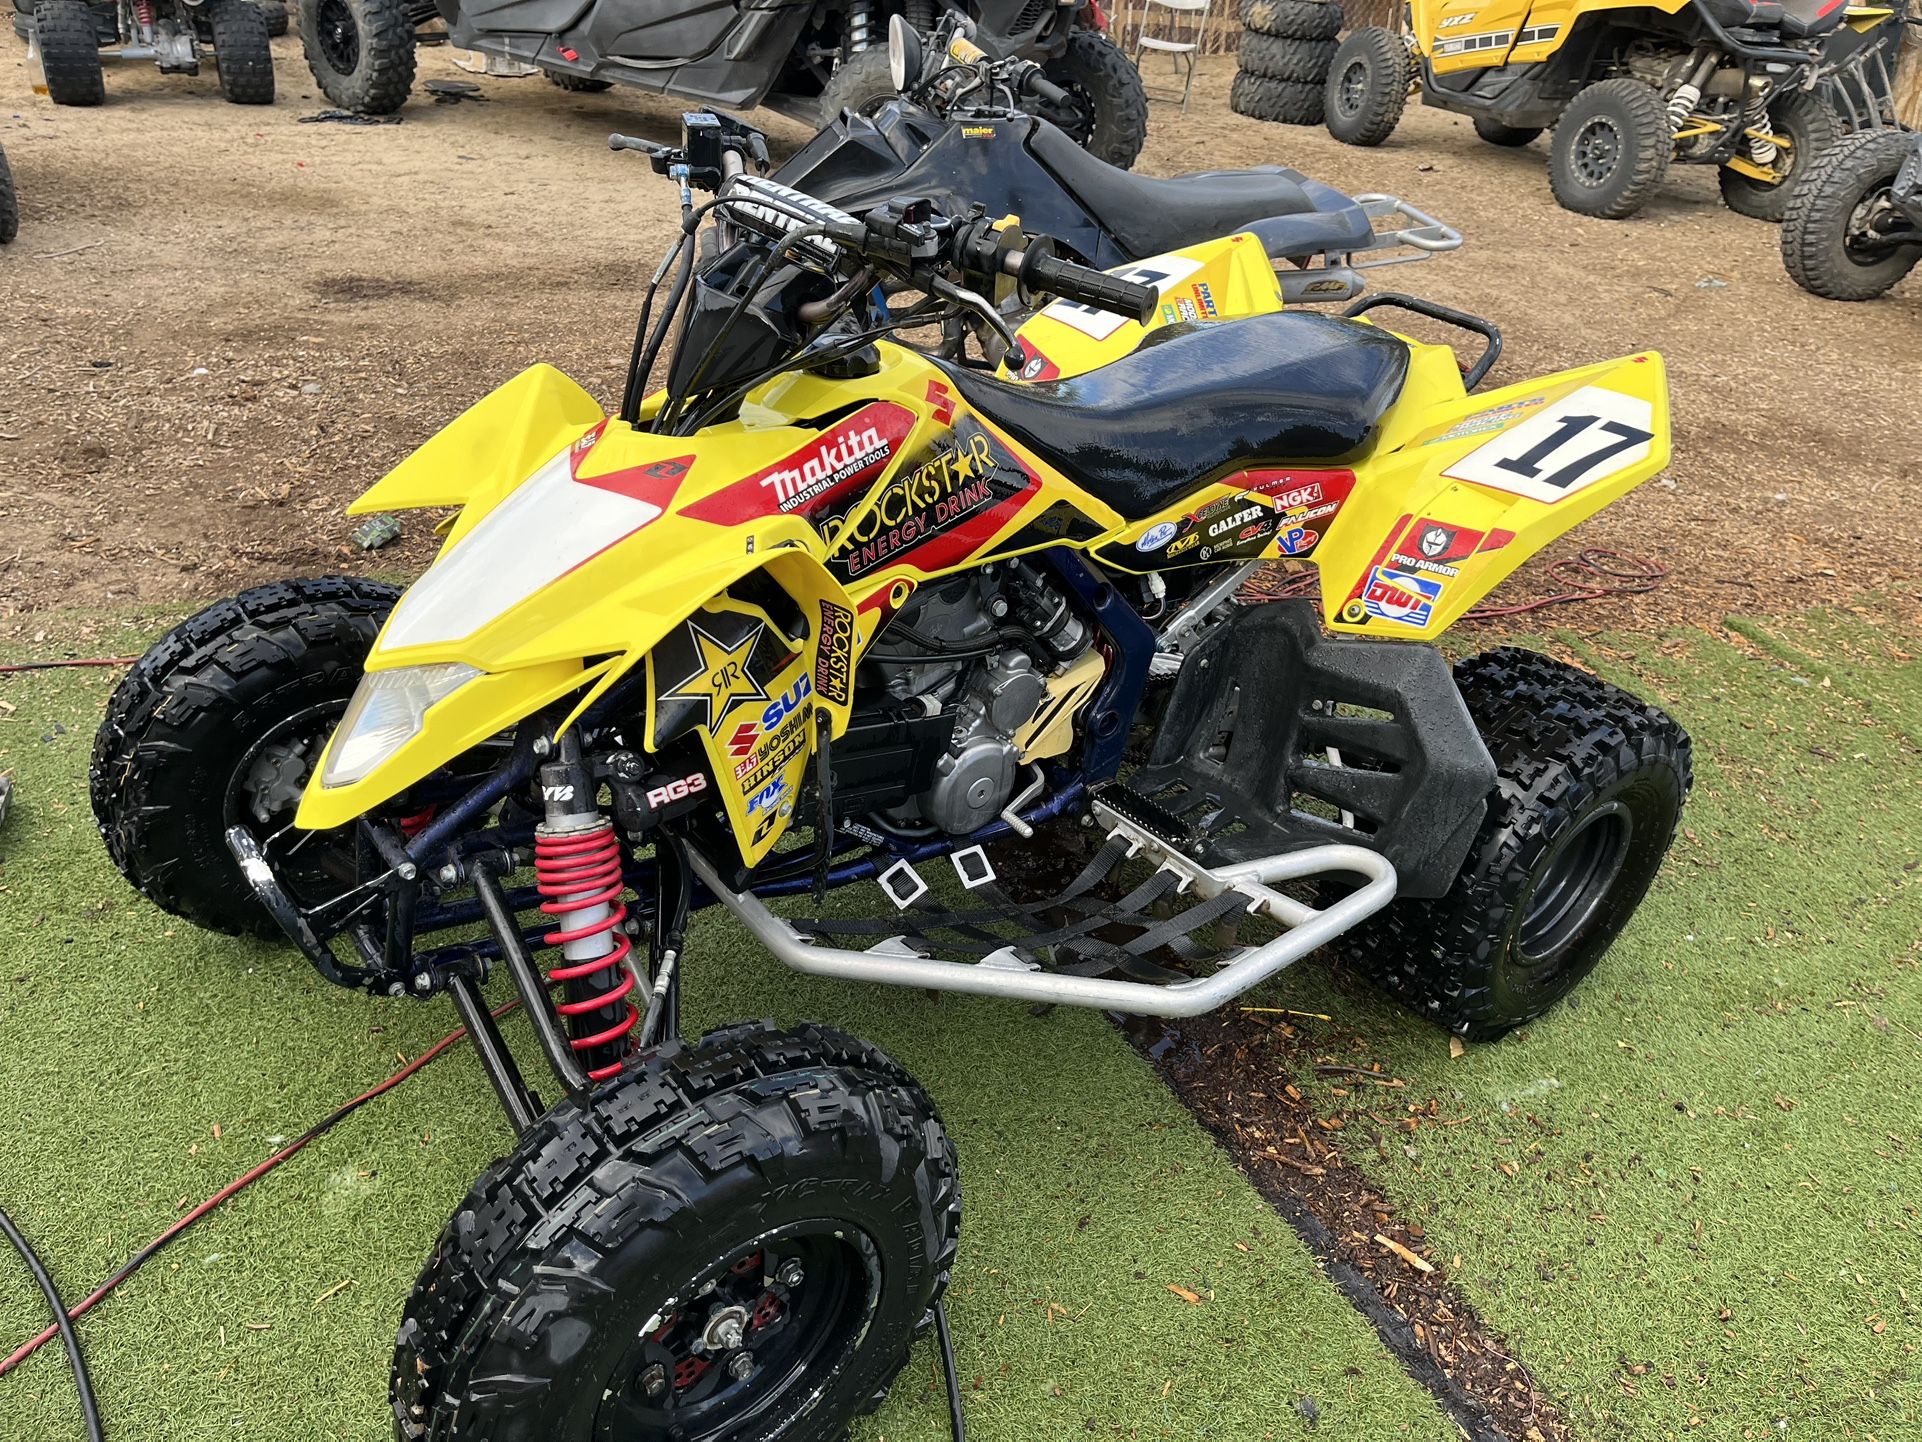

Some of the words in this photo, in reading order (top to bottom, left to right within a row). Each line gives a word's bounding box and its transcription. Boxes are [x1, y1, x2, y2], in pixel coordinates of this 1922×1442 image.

[963, 126, 994, 135] maier
[1494, 415, 1655, 489] 17
[780, 477, 834, 513] INDUSTRIAL
[833, 461, 865, 483] POWER
[863, 445, 890, 466] TOOLS
[850, 512, 926, 572] ENERGY
[936, 477, 991, 523] DRINK
[1208, 505, 1264, 537] GALFER
[1278, 502, 1338, 528] FALICON
[1276, 528, 1304, 554] VP
[1391, 553, 1416, 567] PRO
[1415, 558, 1460, 577] ARMOR
[1365, 581, 1434, 611] DWT
[820, 601, 834, 655] ENERGY
[816, 657, 829, 694] DRINK
[742, 728, 806, 796] HINSON
[646, 773, 707, 809] RG3
